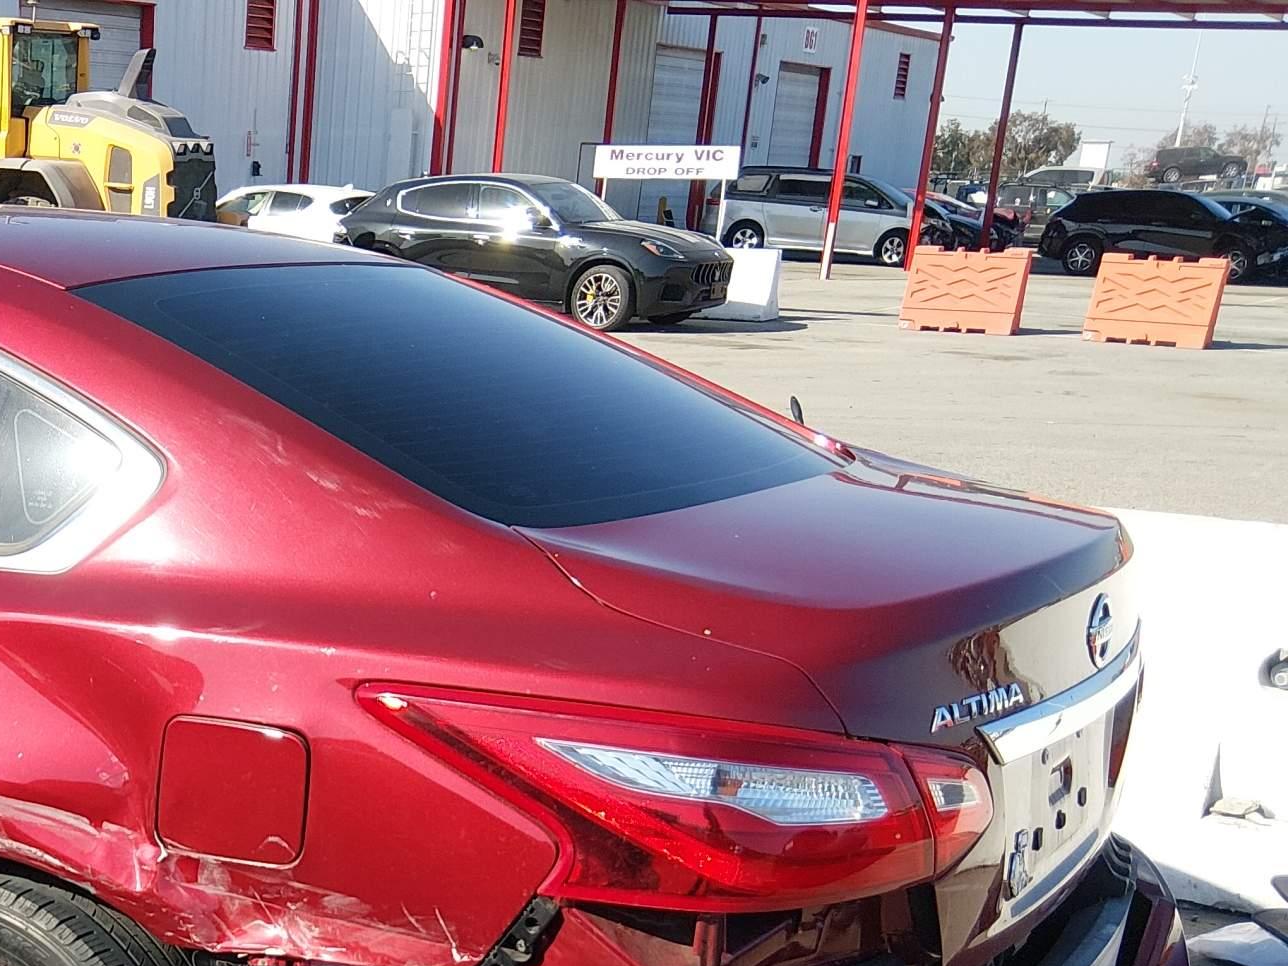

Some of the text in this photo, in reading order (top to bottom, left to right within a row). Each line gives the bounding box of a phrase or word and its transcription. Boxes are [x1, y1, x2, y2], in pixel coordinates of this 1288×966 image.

[54, 113, 89, 124] VOLVO
[610, 149, 725, 163] Mercury VIC
[625, 167, 705, 175] DROP OFF
[930, 682, 1025, 733] ALTIMA
